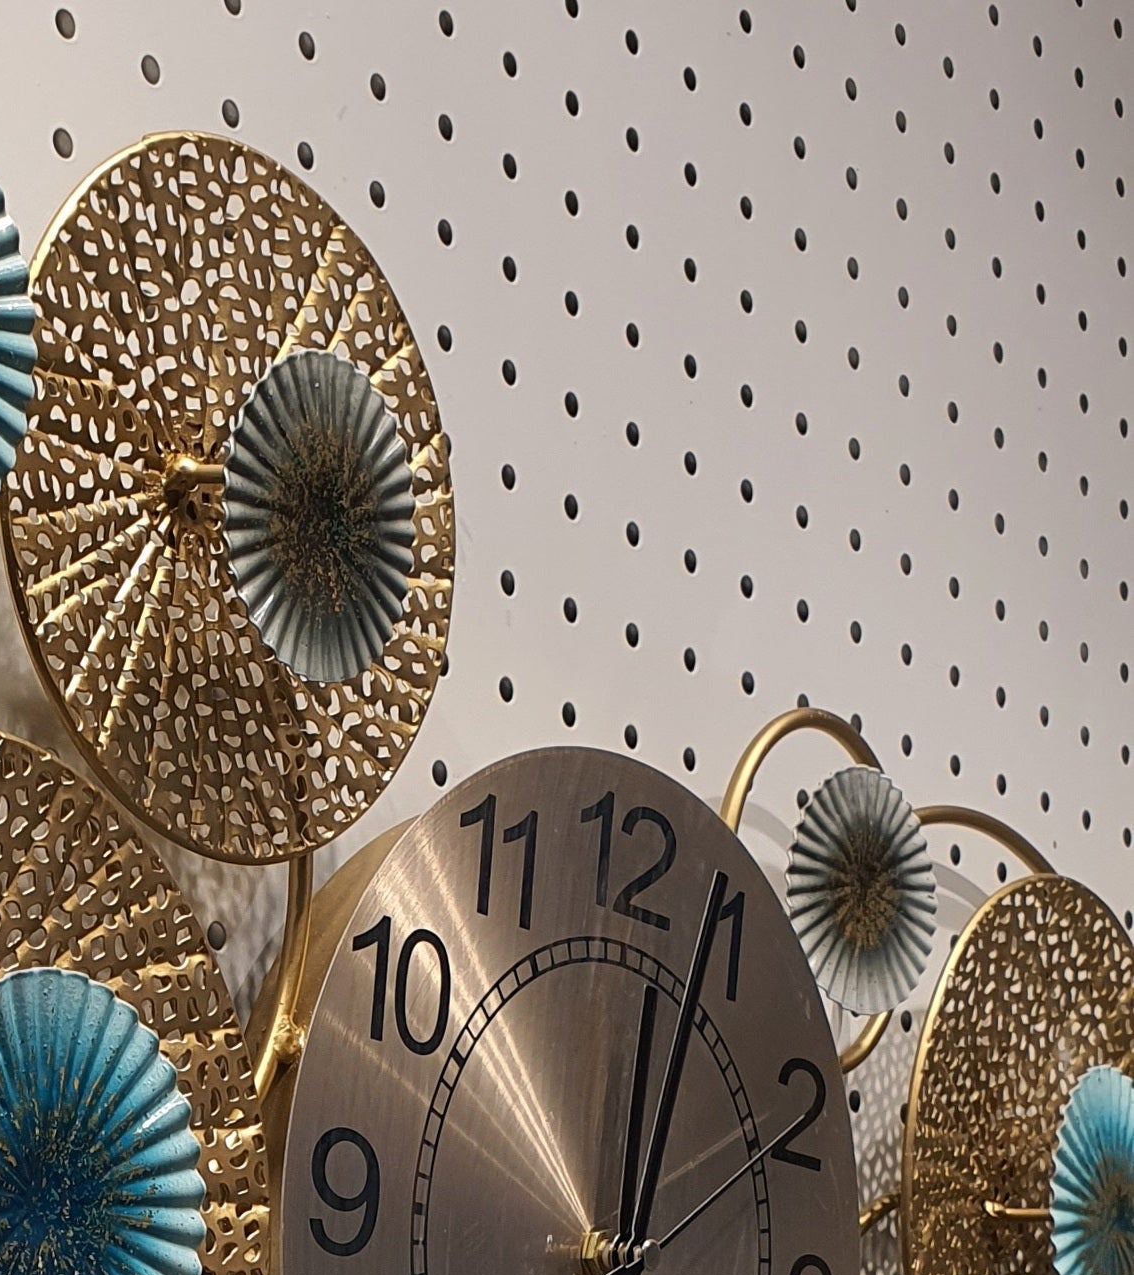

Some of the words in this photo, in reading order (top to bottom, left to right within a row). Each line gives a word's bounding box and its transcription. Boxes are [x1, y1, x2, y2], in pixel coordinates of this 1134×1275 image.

[460, 793, 538, 930] 11
[580, 790, 677, 931] 12
[352, 915, 451, 1056] 10
[717, 891, 745, 1001] 1
[770, 1057, 827, 1172] 2
[309, 1127, 380, 1257] 9
